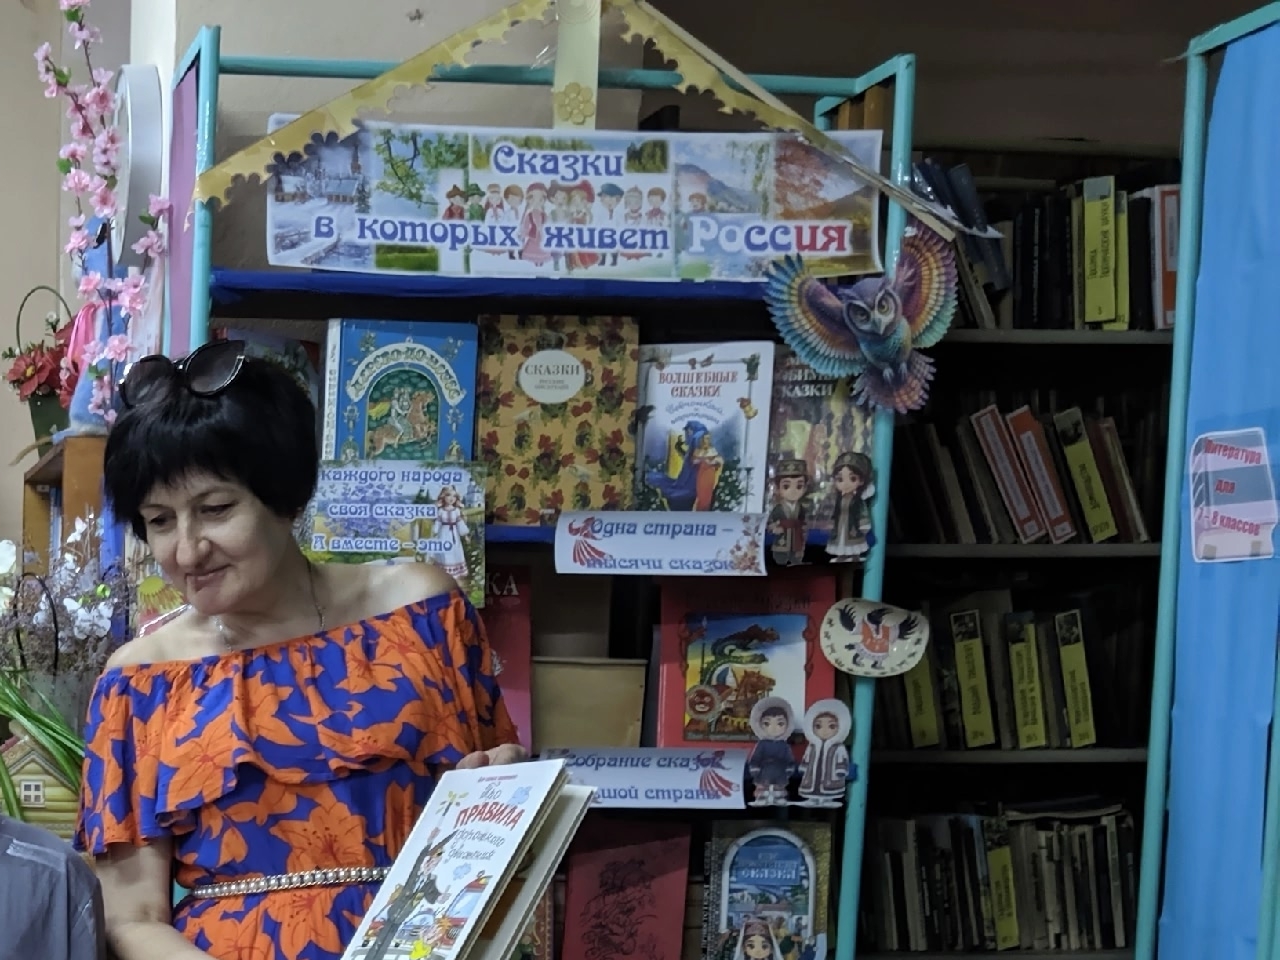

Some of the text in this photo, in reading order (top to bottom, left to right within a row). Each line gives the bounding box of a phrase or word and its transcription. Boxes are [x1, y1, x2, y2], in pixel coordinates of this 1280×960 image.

[493, 145, 623, 182] Сказки
[314, 215, 848, 252] в которых живет Россия
[524, 364, 581, 376] СКАЗКИ
[658, 370, 738, 385] ВОЛШЕБНЫЕ
[670, 385, 722, 398] СКАЗКИ
[320, 469, 463, 486] каждого народа
[328, 504, 437, 520] своя сказка
[590, 517, 638, 539] Одна
[642, 520, 717, 539] страна
[1219, 514, 1261, 536] классов
[312, 534, 326, 551] А
[331, 538, 399, 551] вместе
[419, 539, 453, 551] это
[586, 557, 737, 574] тысячи сказок
[565, 752, 652, 772] Собрание
[644, 787, 720, 803] страны
[454, 801, 526, 831] ПРАВИЛА
